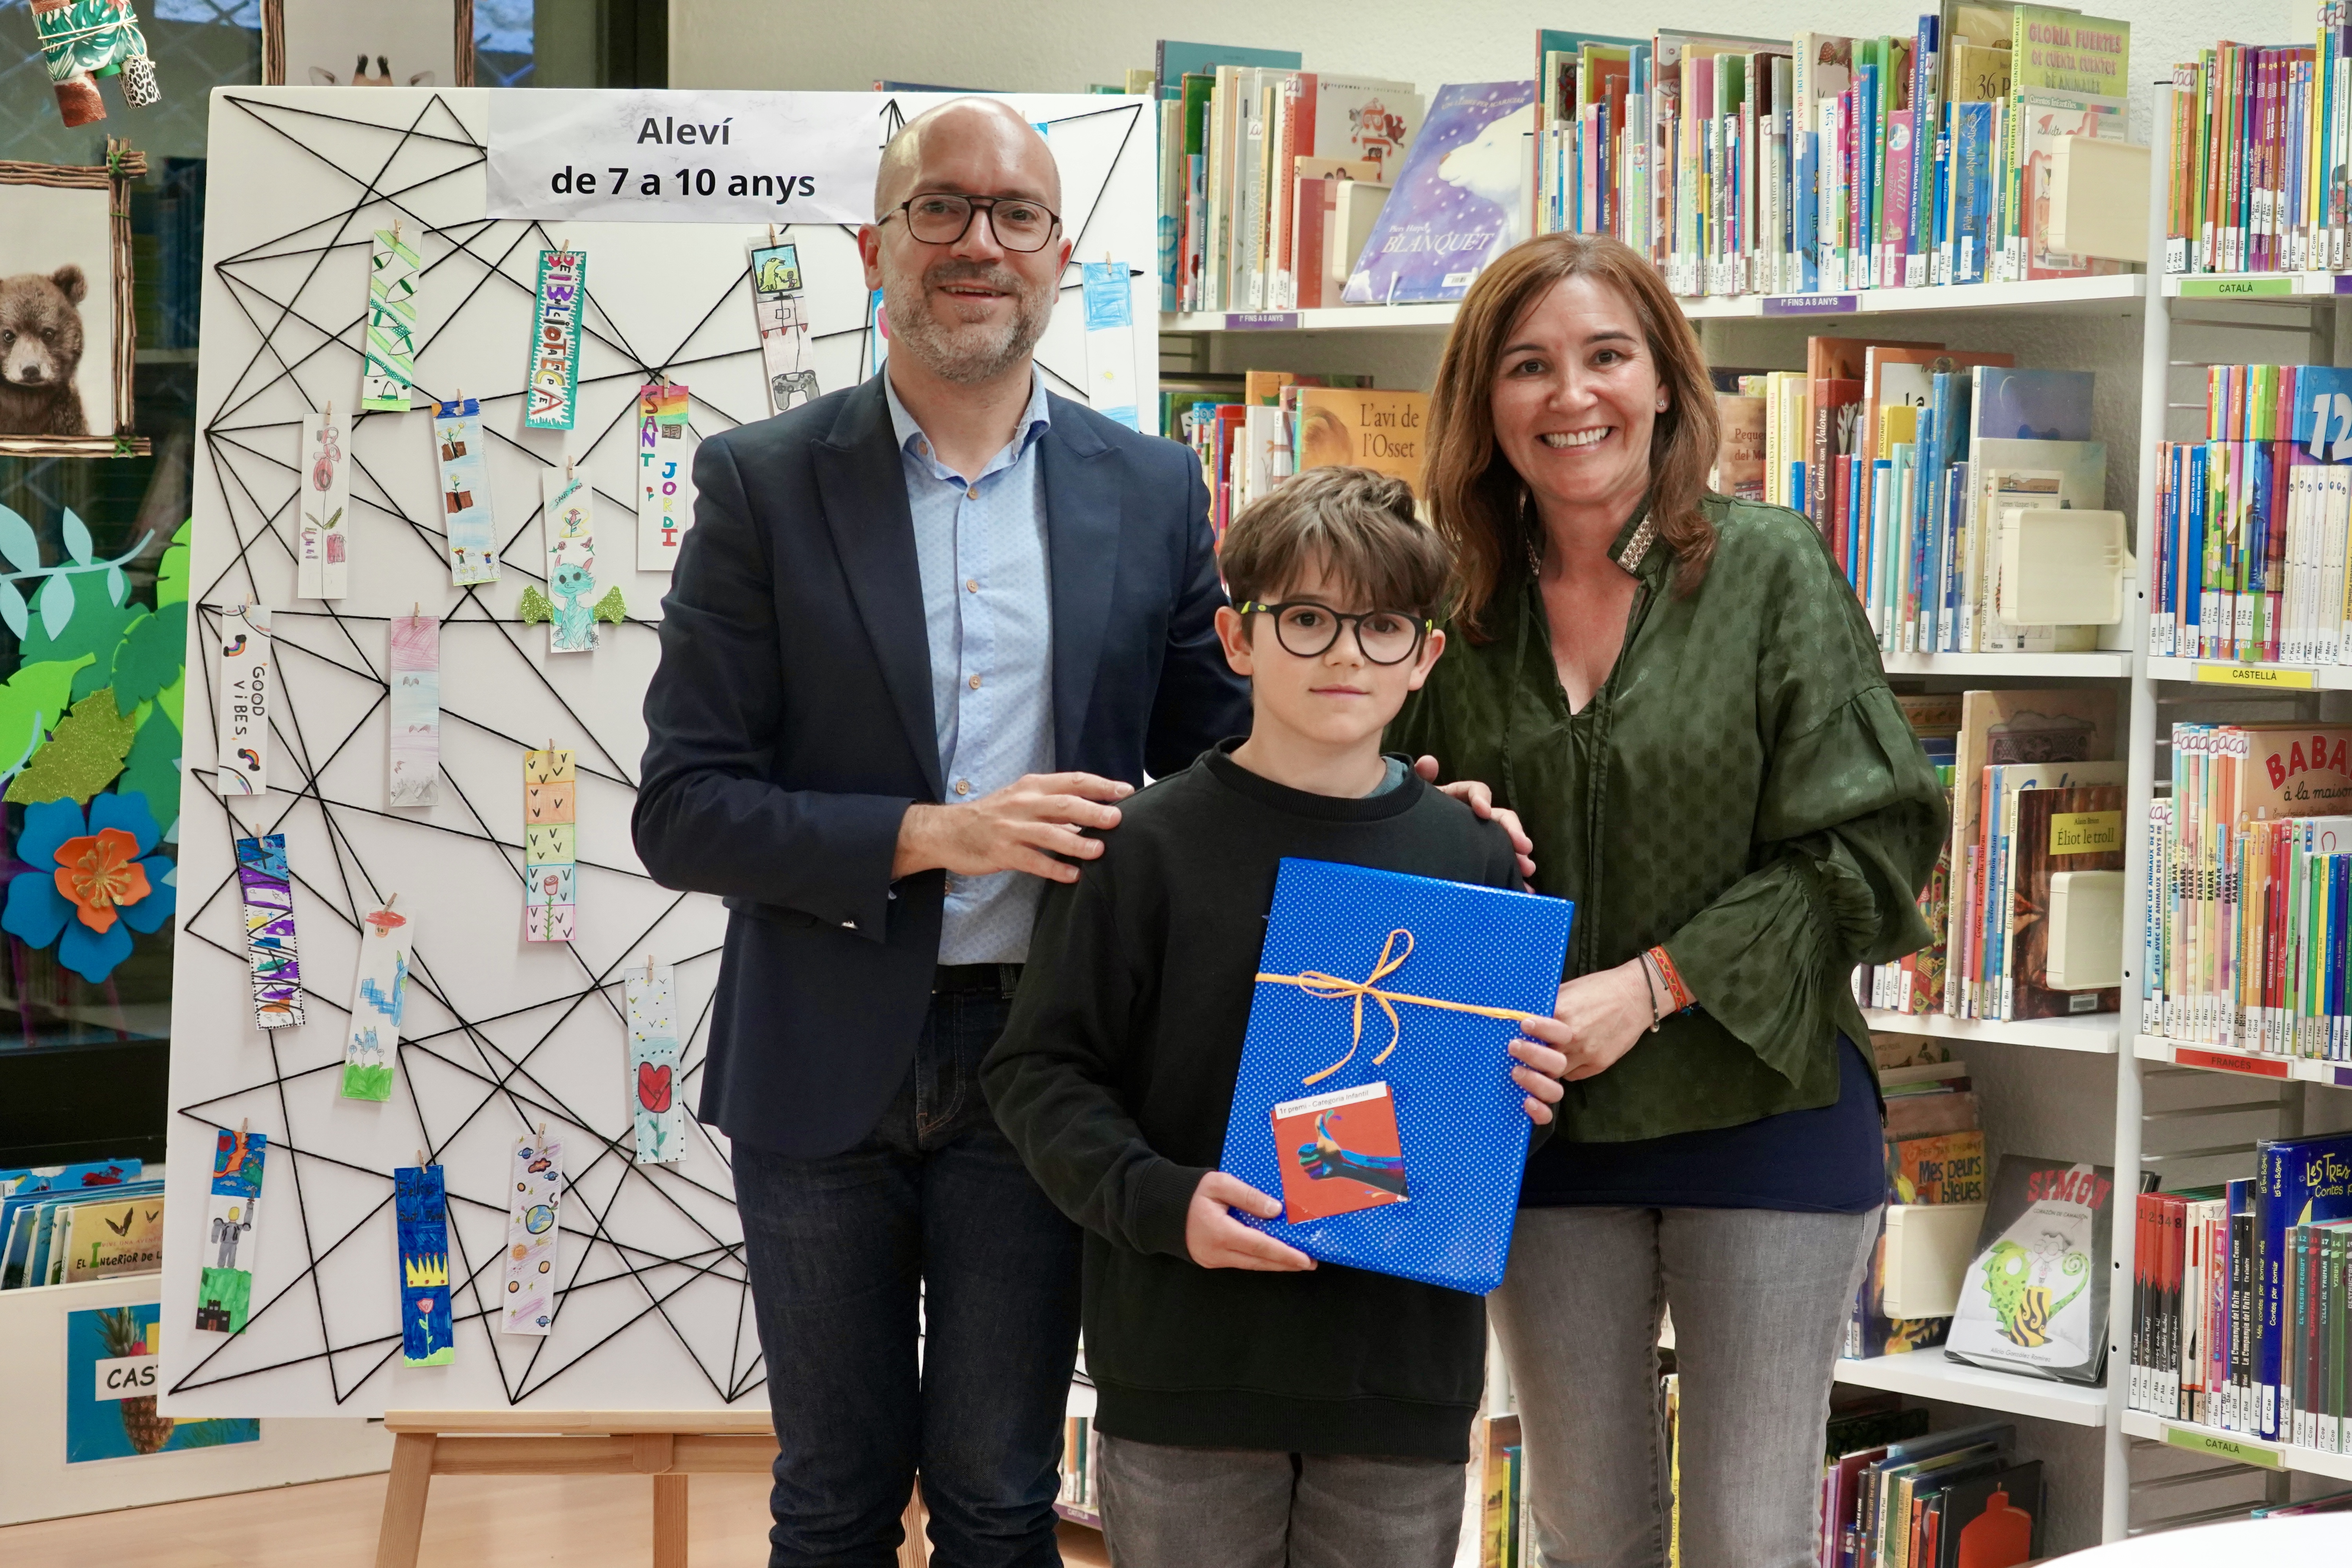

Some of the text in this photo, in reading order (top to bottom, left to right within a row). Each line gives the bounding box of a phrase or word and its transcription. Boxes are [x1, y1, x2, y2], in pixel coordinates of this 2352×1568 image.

[2029, 22, 2122, 54] GLORIA FUERTES
[2014, 49, 2019, 57] DE
[2032, 47, 2116, 76] OS CUENTA CUENTOS
[1977, 73, 1996, 100] 36
[2030, 95, 2076, 109] Cuentos Infantiles
[637, 117, 734, 145] Aleví
[552, 166, 815, 204] de 7 a 10 anys
[1772, 211, 1777, 220] MI
[1381, 233, 1495, 255] BLANQUET
[2219, 283, 2253, 292] CATALÀ
[1788, 297, 1802, 306] FINS
[1804, 297, 1809, 305] A
[1811, 297, 1817, 305] 8
[1818, 296, 1838, 306] ANYS
[1360, 403, 1419, 428] L'avi de
[1815, 409, 1827, 445] Valores
[1363, 433, 1415, 458] l'Osset
[1814, 463, 1826, 500] Cuentos
[1927, 480, 1935, 535] L'EXTRATERRESTRE
[2232, 669, 2277, 681] CASTELLÀ
[252, 667, 265, 716] GOOD
[2265, 734, 2352, 792] BABA
[2284, 786, 2292, 801] à
[2295, 780, 2310, 800] la
[2057, 828, 2114, 846] Éliot le troll
[2005, 912, 2013, 929] Éliot
[2211, 1057, 2252, 1070] FRANCÈS
[1289, 1103, 1307, 1114] premi
[1312, 1095, 1345, 1108] Categoria
[1346, 1090, 1369, 1102] Infantil
[1919, 1156, 1981, 1189] Mes peurs
[1942, 1181, 1981, 1203] bleues
[2315, 1185, 2343, 1198] Contes
[76, 1259, 86, 1269] EL
[1991, 1348, 2004, 1356] Alicia
[2005, 1349, 2030, 1359] González
[2231, 1356, 2239, 1364] La
[106, 1366, 158, 1389] CAS
[2206, 1439, 2240, 1454] CATALÀ
